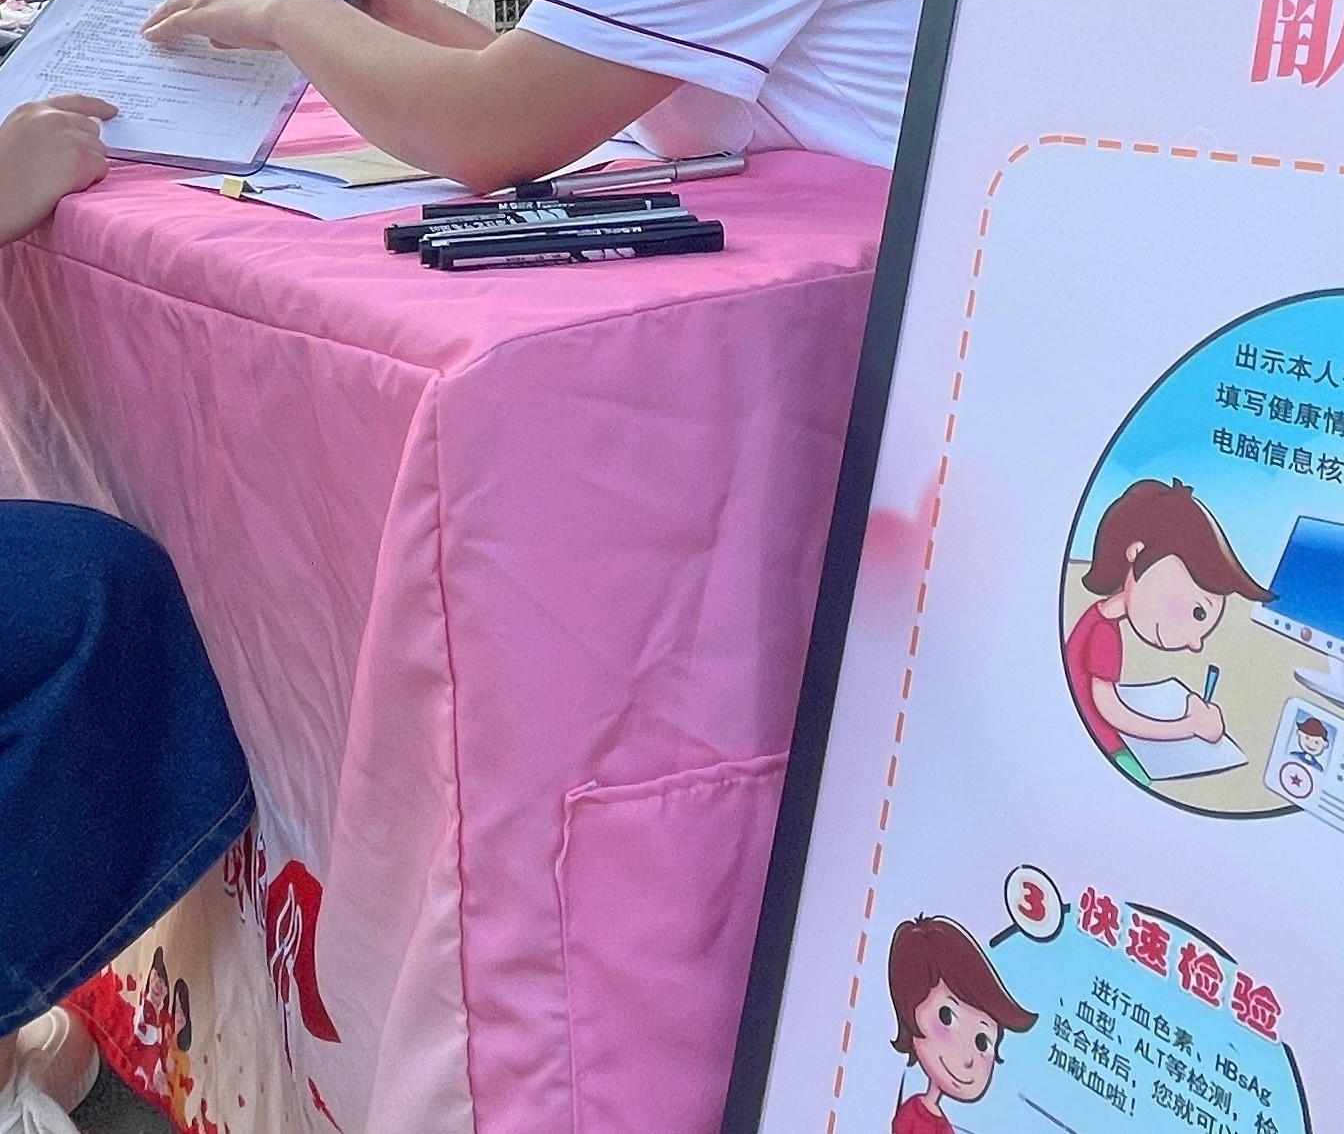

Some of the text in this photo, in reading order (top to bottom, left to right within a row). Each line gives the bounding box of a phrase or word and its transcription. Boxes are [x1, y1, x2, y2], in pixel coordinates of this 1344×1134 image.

[1018, 881, 1047, 922] 3
[1077, 887, 1282, 1041] 快速检验
